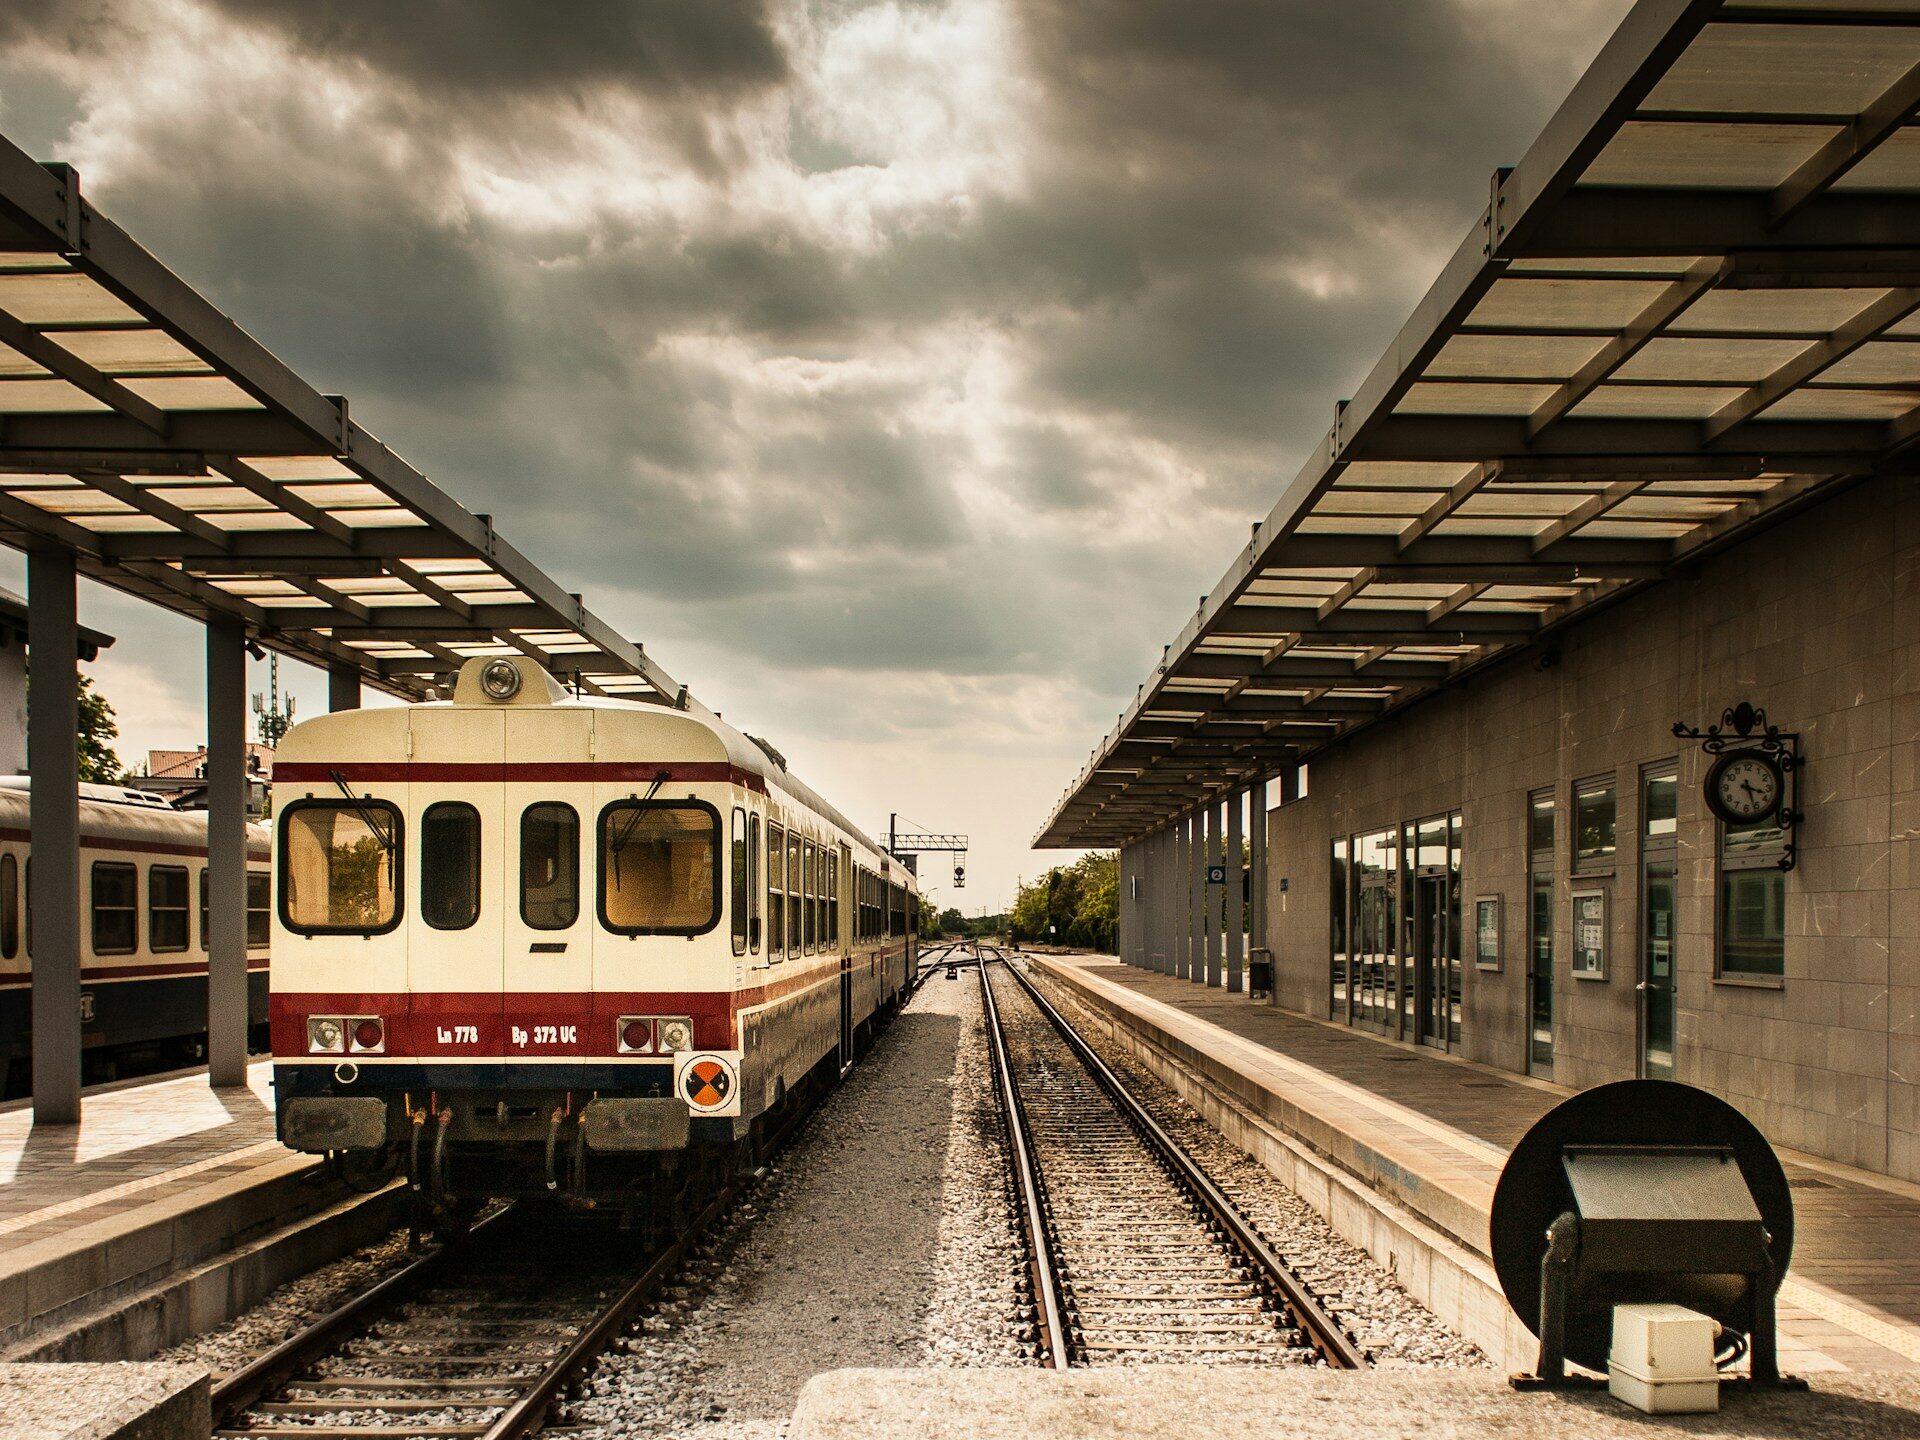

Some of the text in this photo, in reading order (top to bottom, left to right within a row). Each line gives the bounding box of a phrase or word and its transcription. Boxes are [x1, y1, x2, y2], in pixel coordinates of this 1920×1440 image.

[437, 1026, 478, 1044] Ln 778
[512, 1026, 577, 1048] Bp 372 UC
